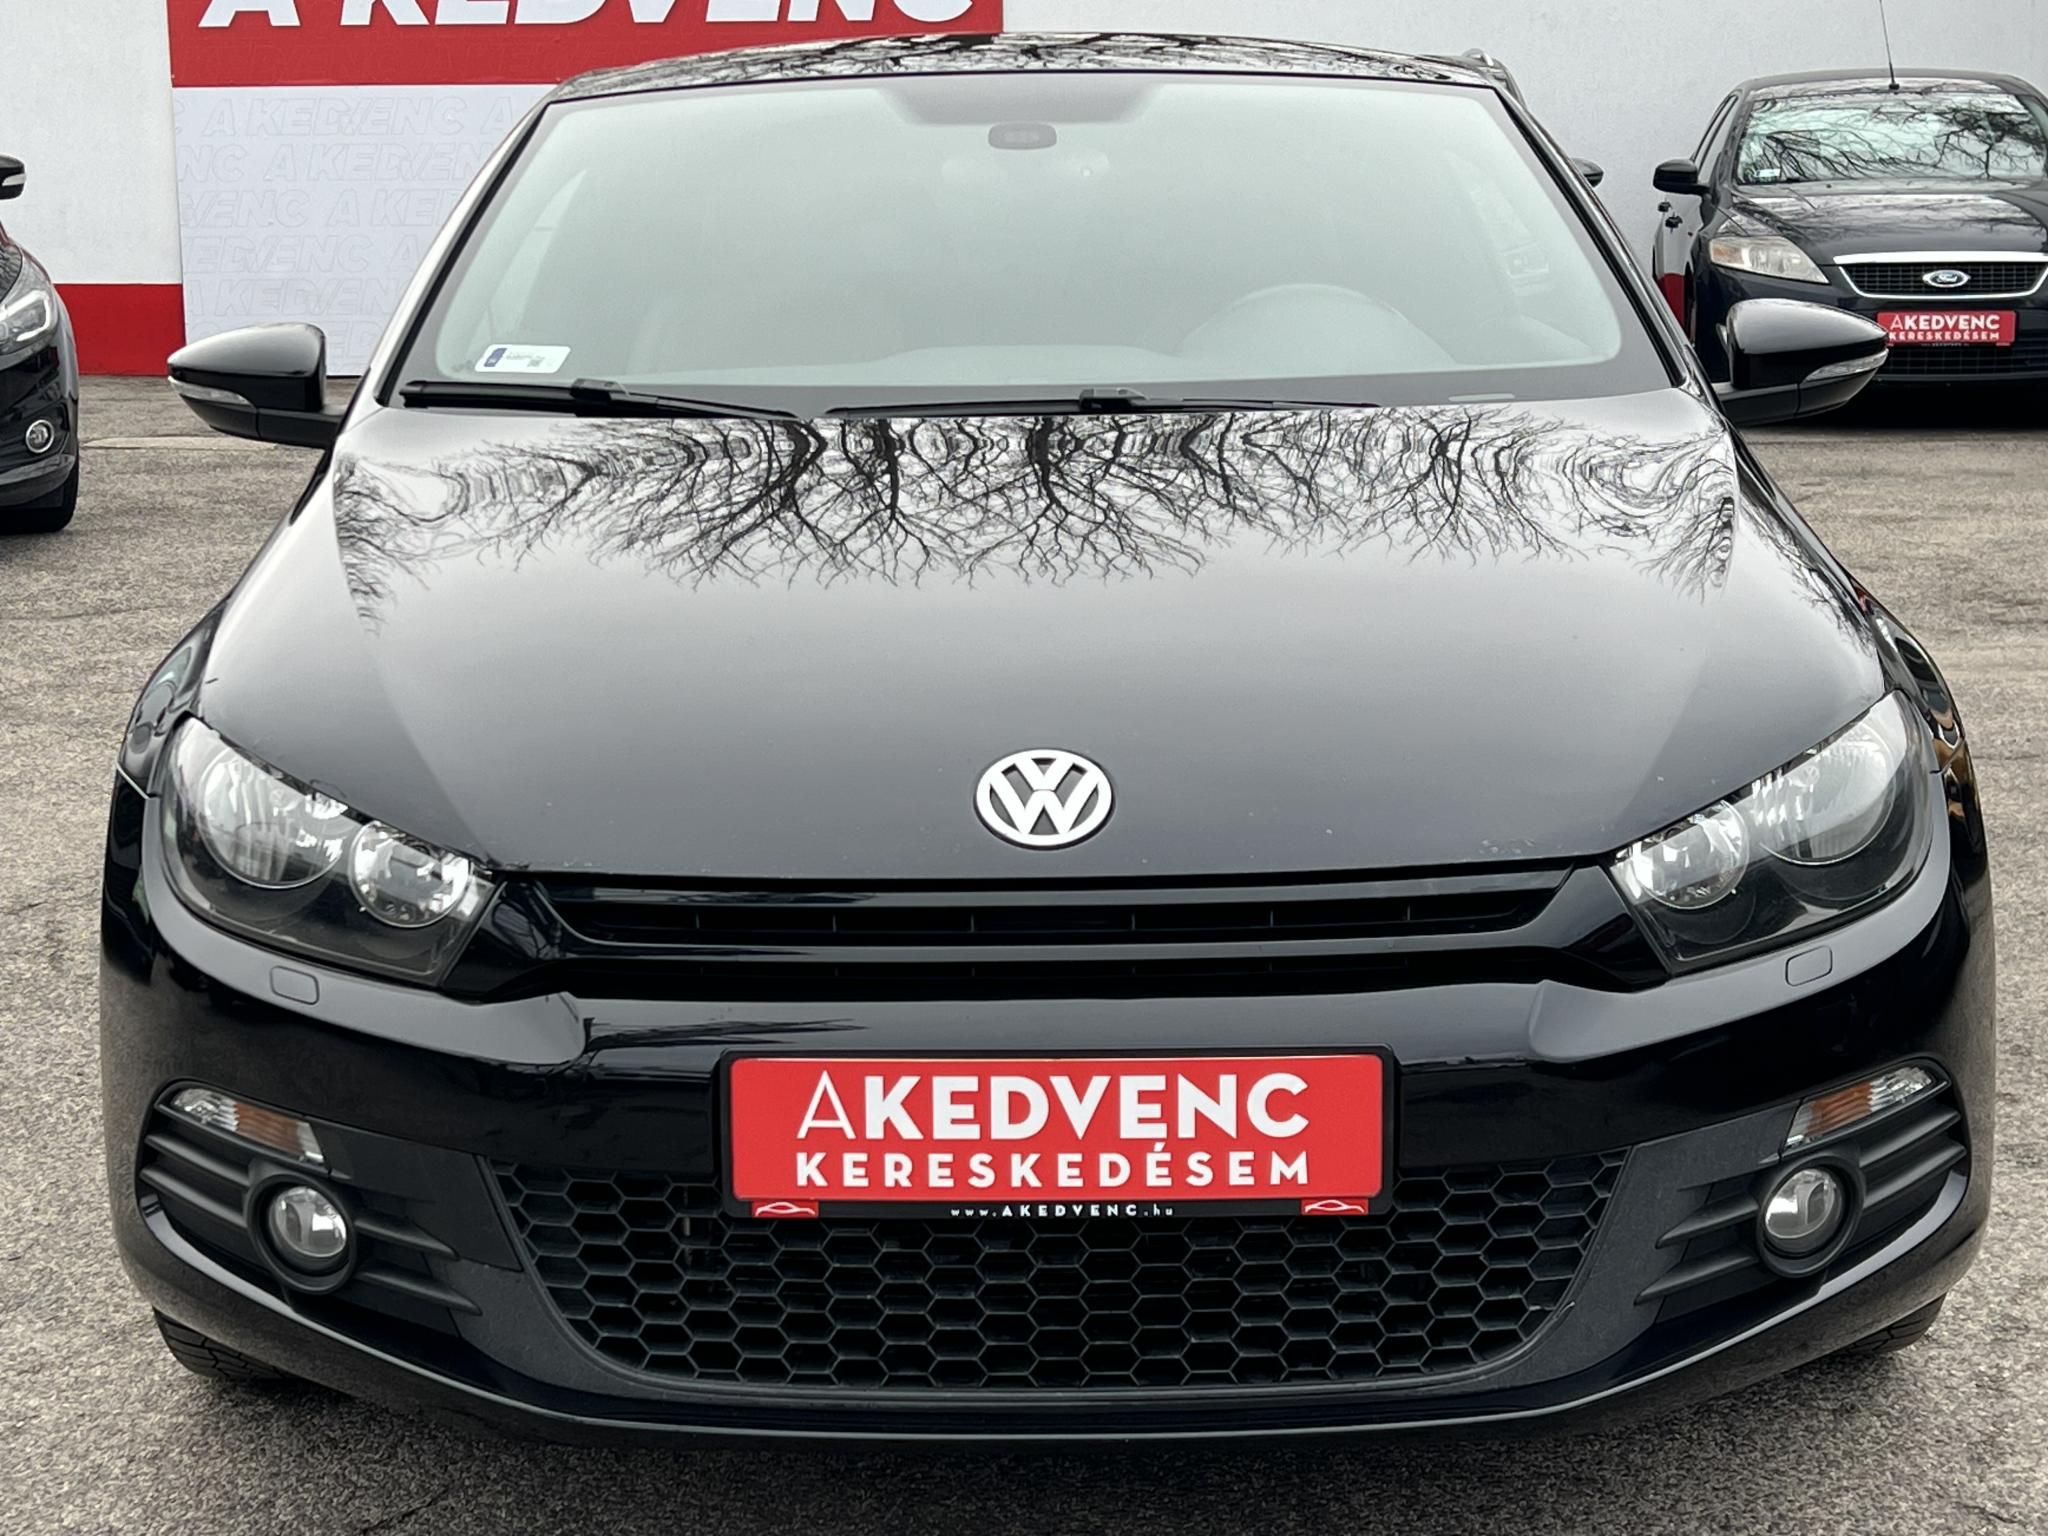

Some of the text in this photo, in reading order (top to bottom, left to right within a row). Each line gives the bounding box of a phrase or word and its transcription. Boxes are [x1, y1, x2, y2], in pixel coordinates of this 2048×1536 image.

[1889, 314, 2000, 330] AKEDVENC
[797, 1070, 1309, 1140] AKEDVENC
[796, 1141, 1308, 1188] KERESKEDÉSEM
[950, 1203, 1174, 1218] www.AKEDVENC.hu
